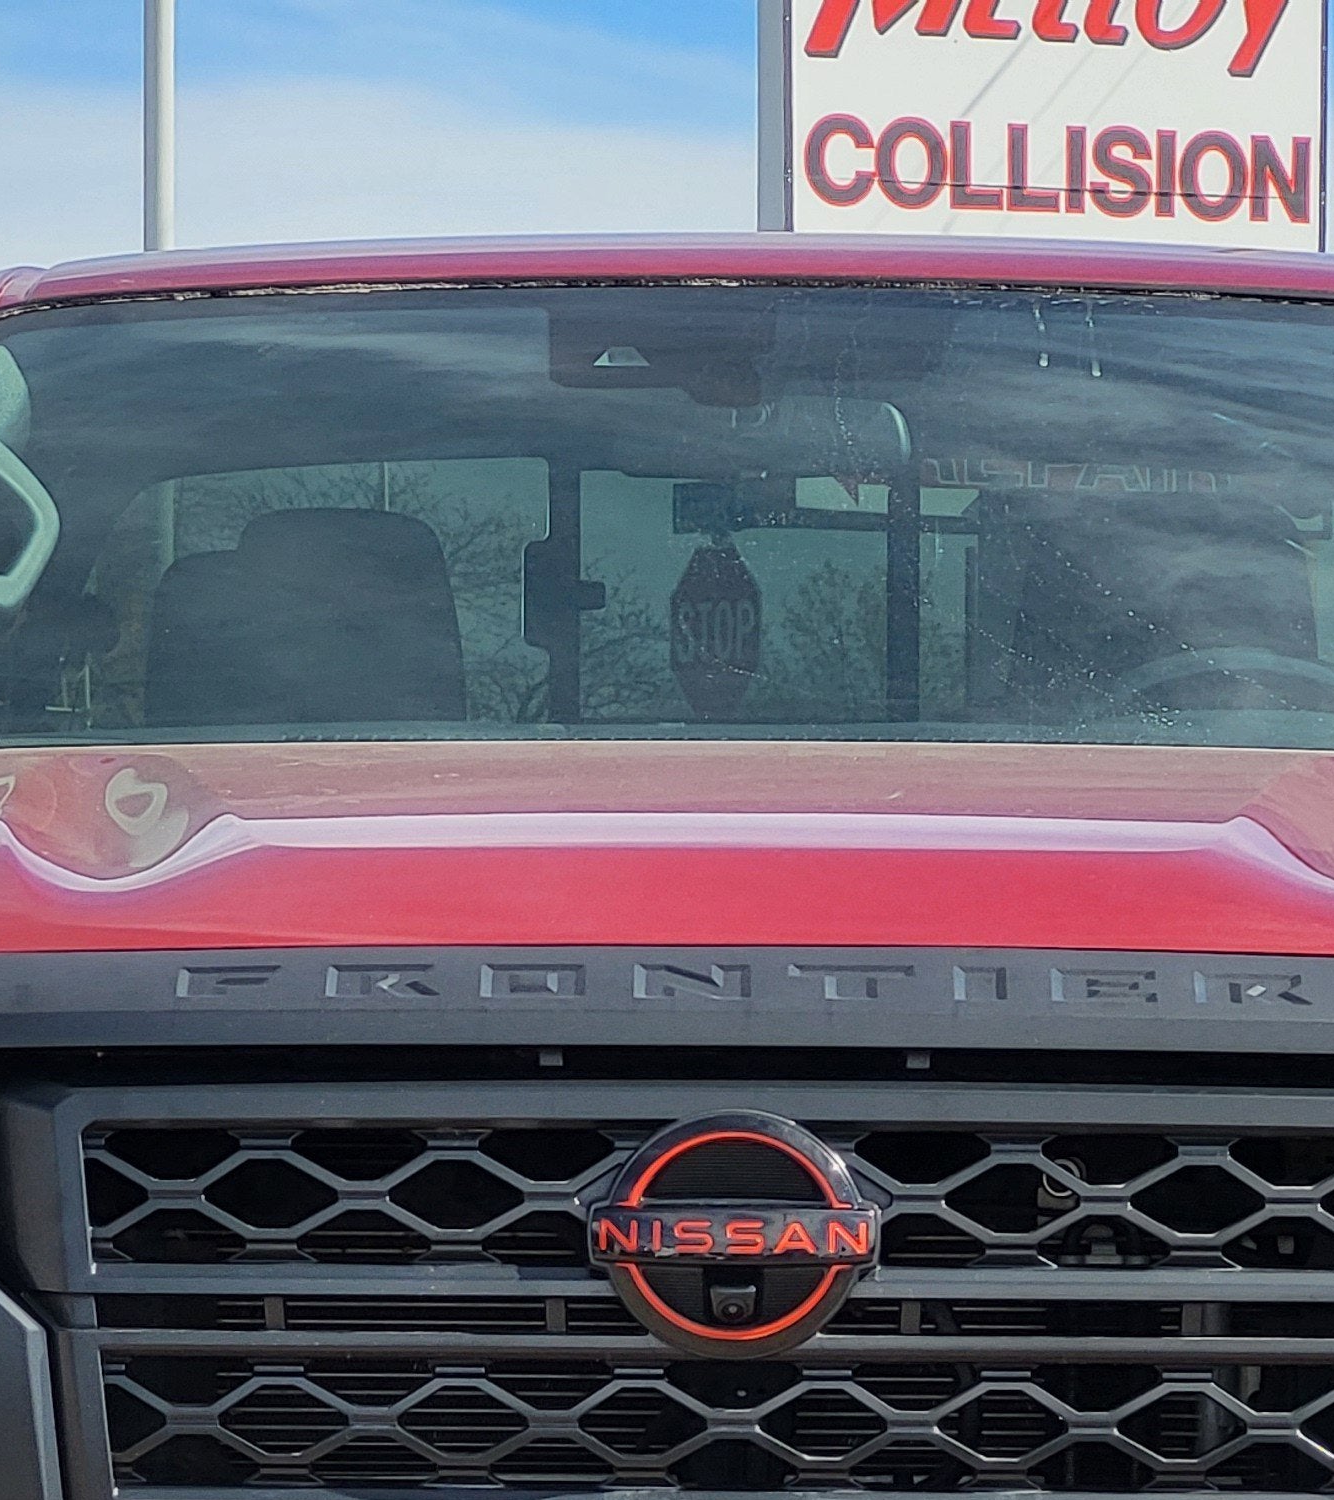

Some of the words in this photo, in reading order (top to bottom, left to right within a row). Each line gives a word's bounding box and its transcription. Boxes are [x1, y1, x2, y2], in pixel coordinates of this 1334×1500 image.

[803, 113, 1312, 224] COLLISION
[675, 601, 755, 663] STOP
[175, 963, 1314, 1006] FRONTIER
[597, 1218, 869, 1256] NISSAN
